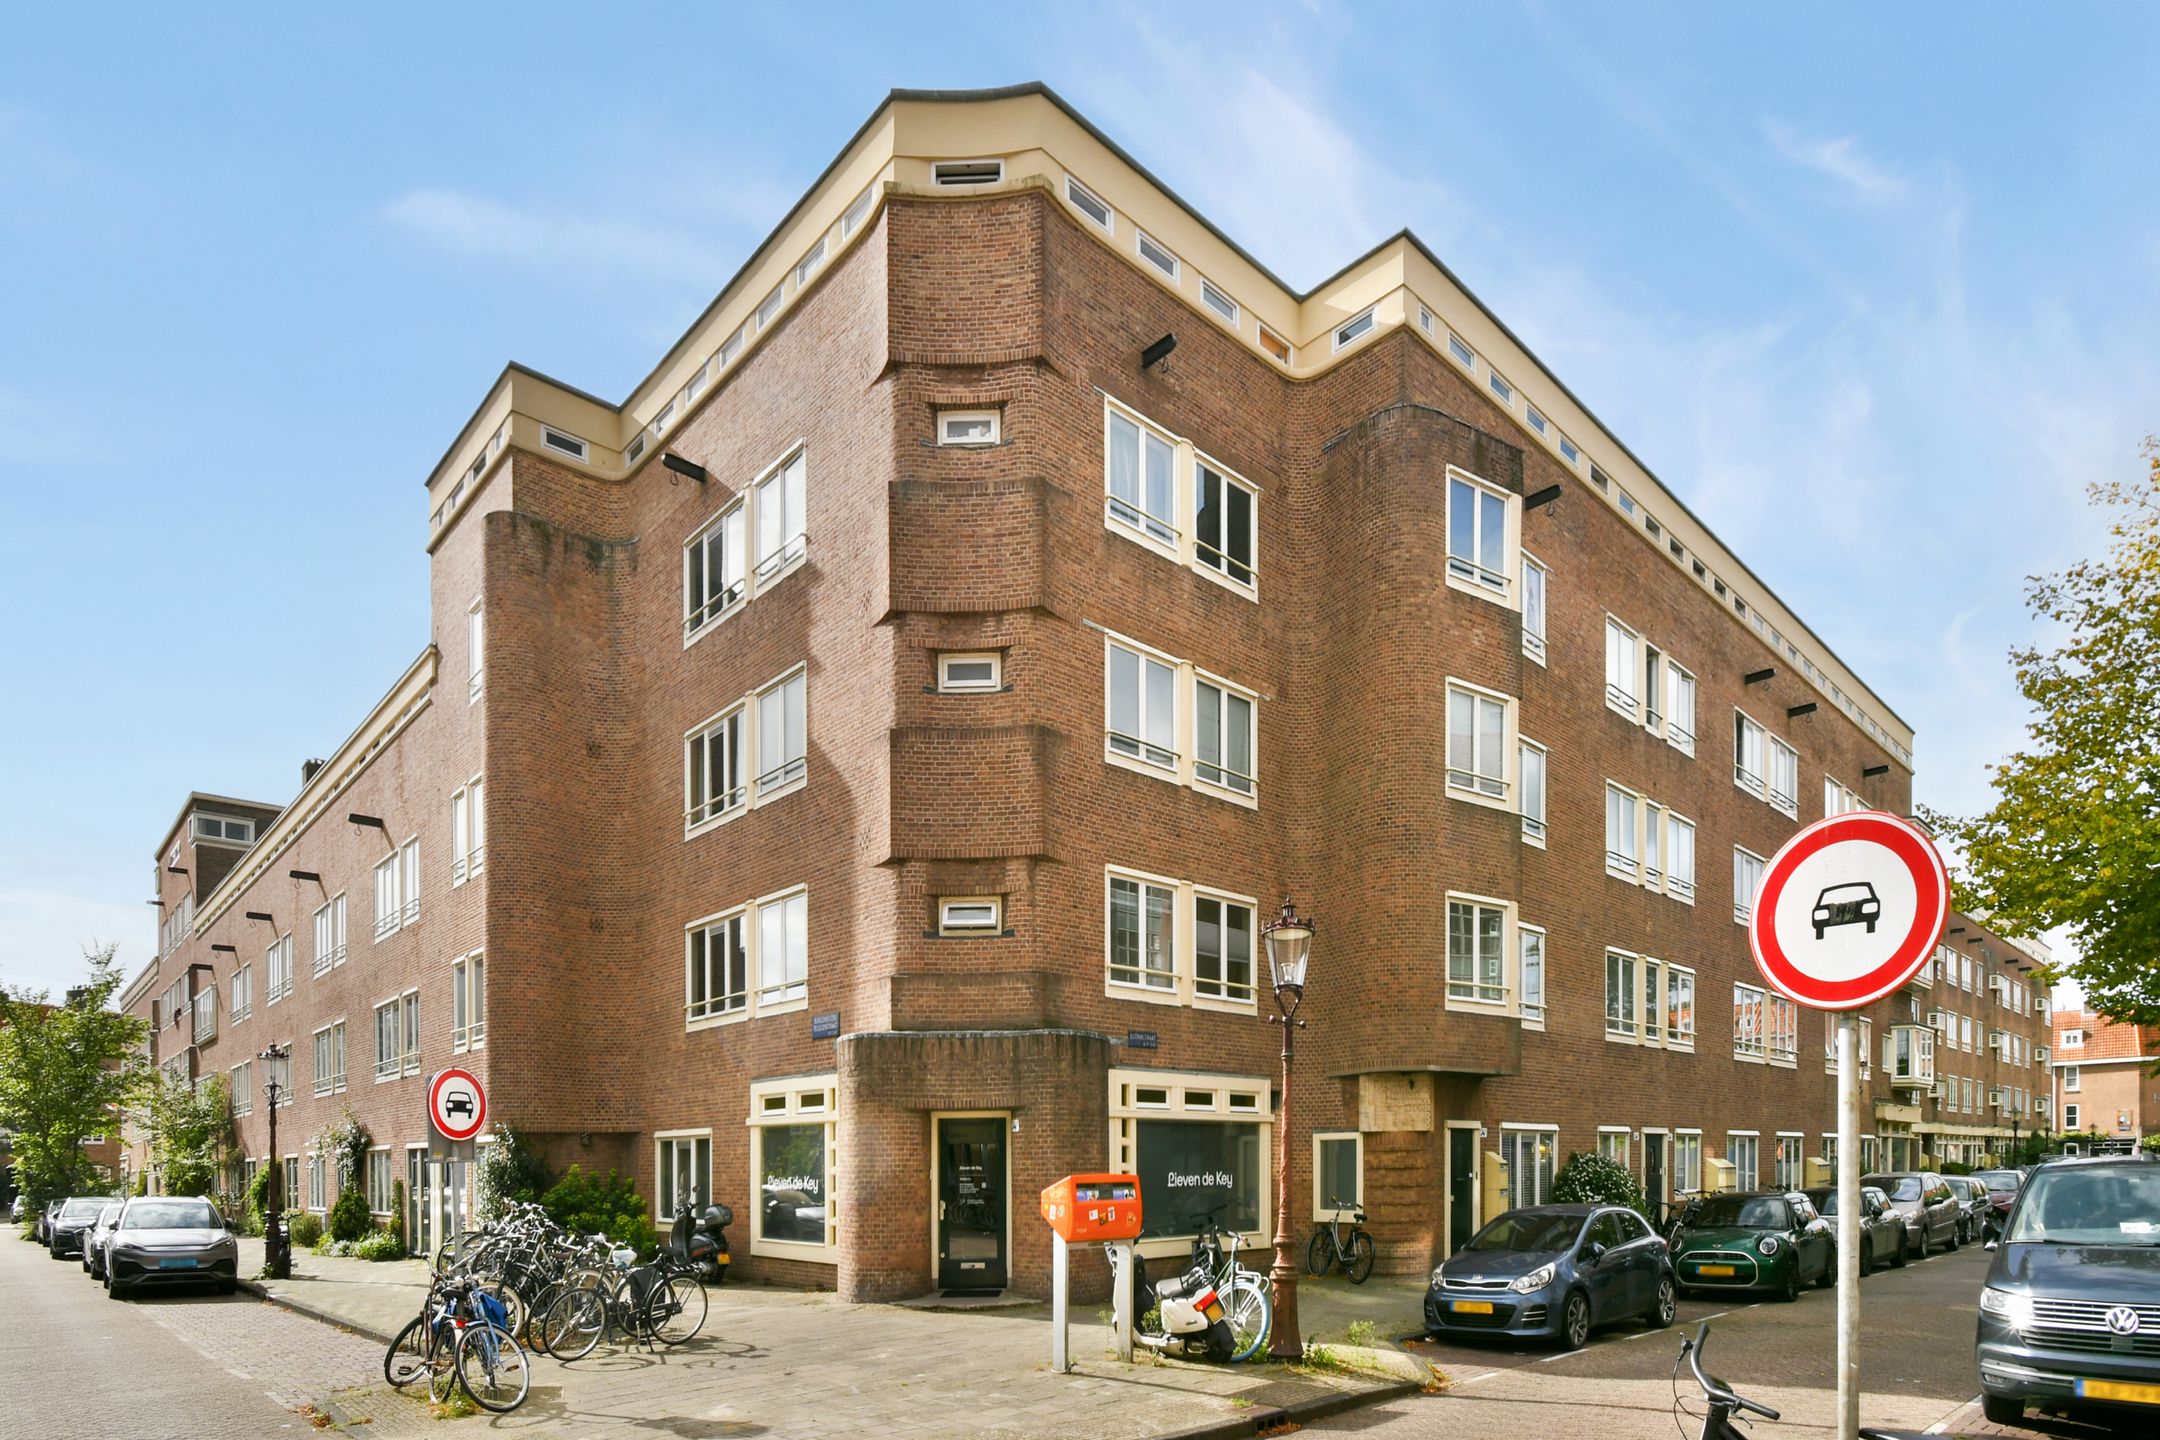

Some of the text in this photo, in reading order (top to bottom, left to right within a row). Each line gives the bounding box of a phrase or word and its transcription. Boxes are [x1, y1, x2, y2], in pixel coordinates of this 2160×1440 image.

[792, 1175, 803, 1190] de
[804, 1175, 819, 1194] Key
[1167, 1171, 1233, 1189] Lieven de Key
